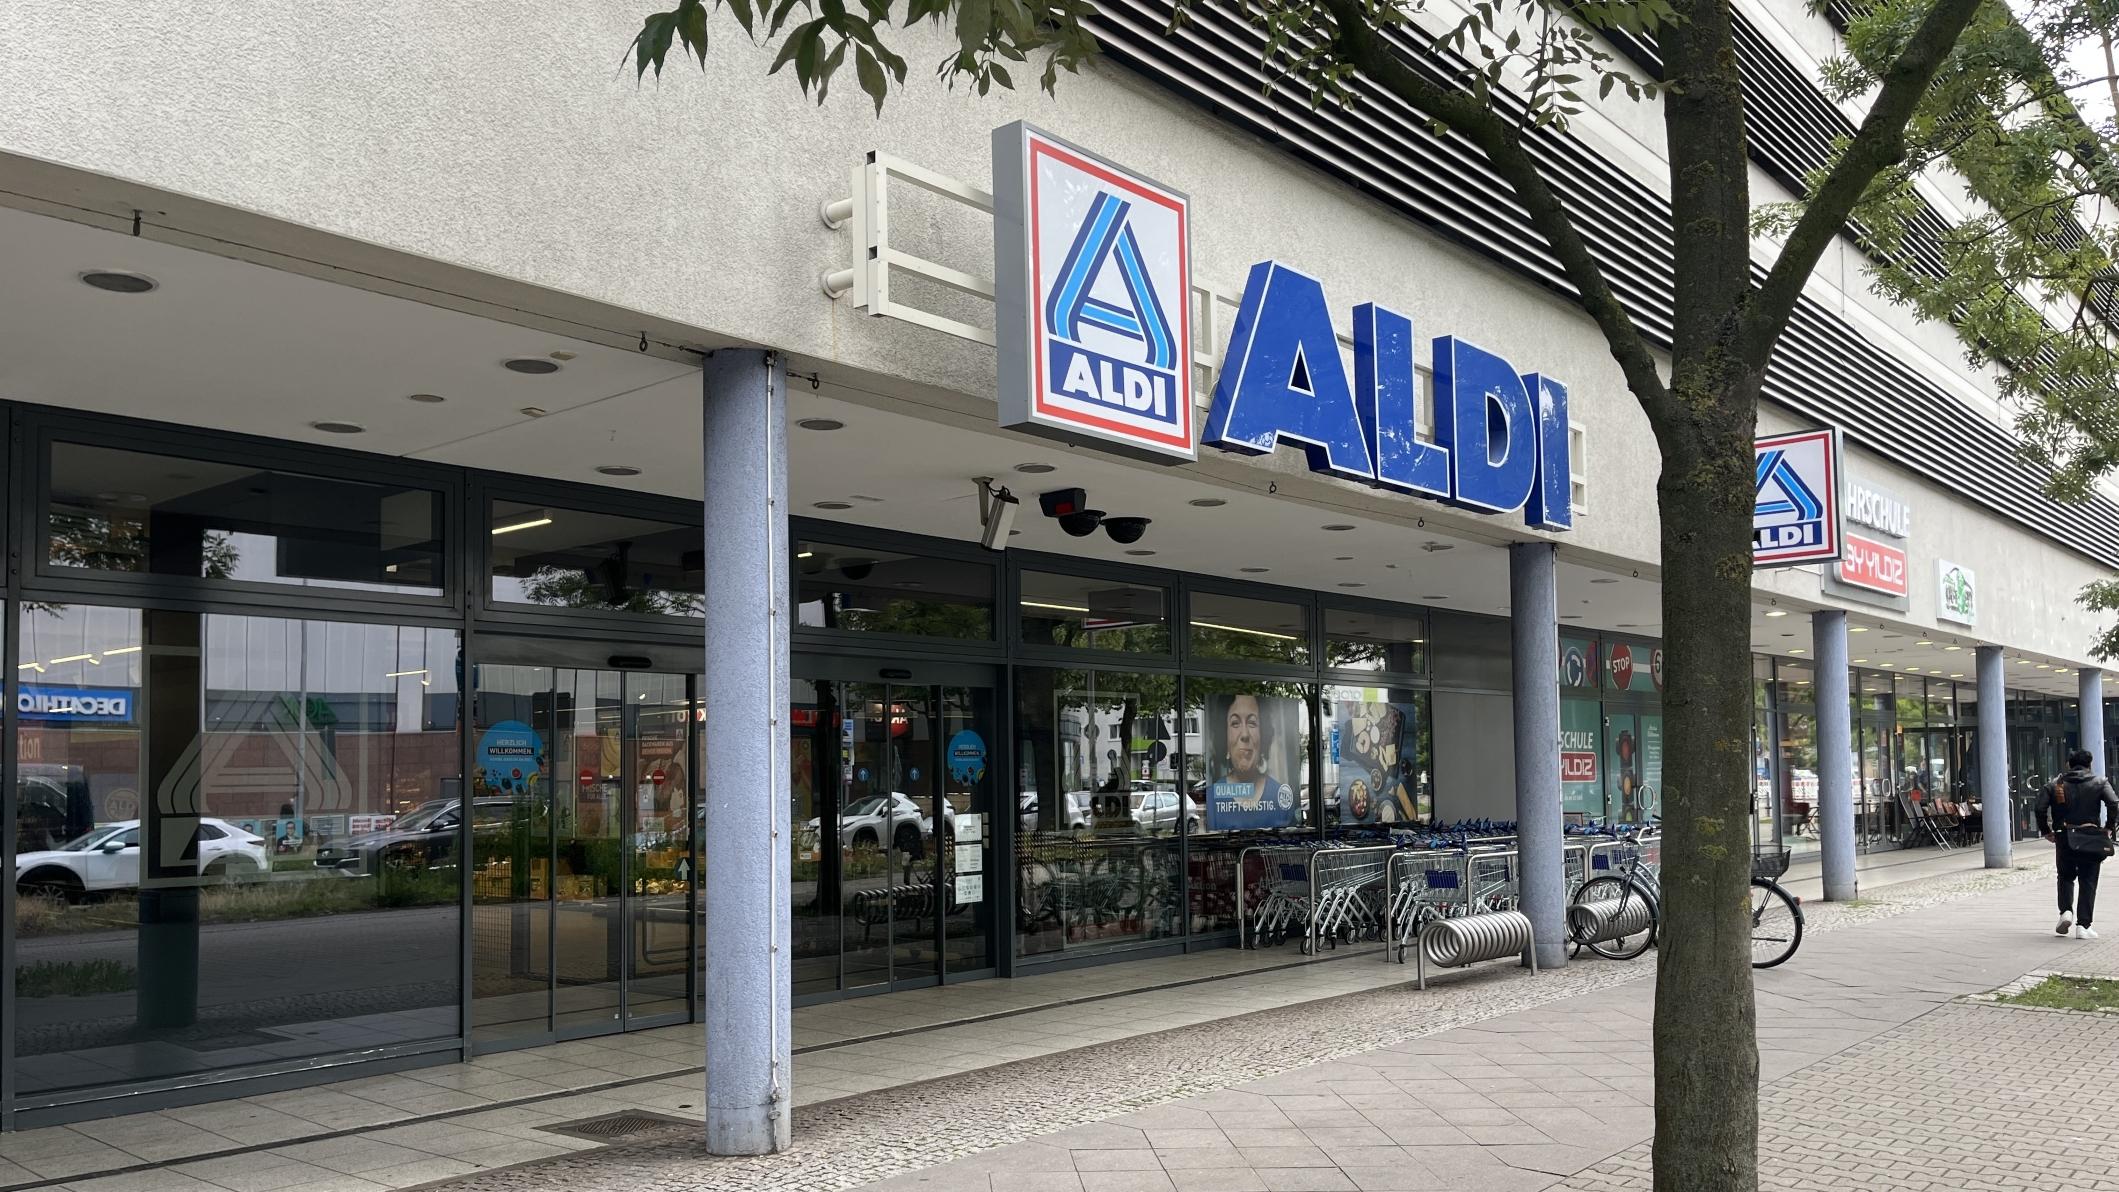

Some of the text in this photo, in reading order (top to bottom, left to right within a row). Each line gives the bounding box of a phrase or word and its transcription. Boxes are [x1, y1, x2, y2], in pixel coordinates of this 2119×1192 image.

[1062, 352, 1167, 416] ALDI
[1200, 260, 1573, 532] ALDI
[1845, 482, 1911, 538] HRSCHULE
[1865, 550, 1904, 586] YILDIZ
[1612, 656, 1630, 673] STOP
[496, 739, 527, 747] HERZLICH
[1560, 731, 1594, 749] SCHULE
[489, 747, 532, 755] WILLKOMMEN.
[1215, 784, 1252, 797] QUALITÄT
[1215, 799, 1277, 813] TRIFFT GÜNSTIG.
